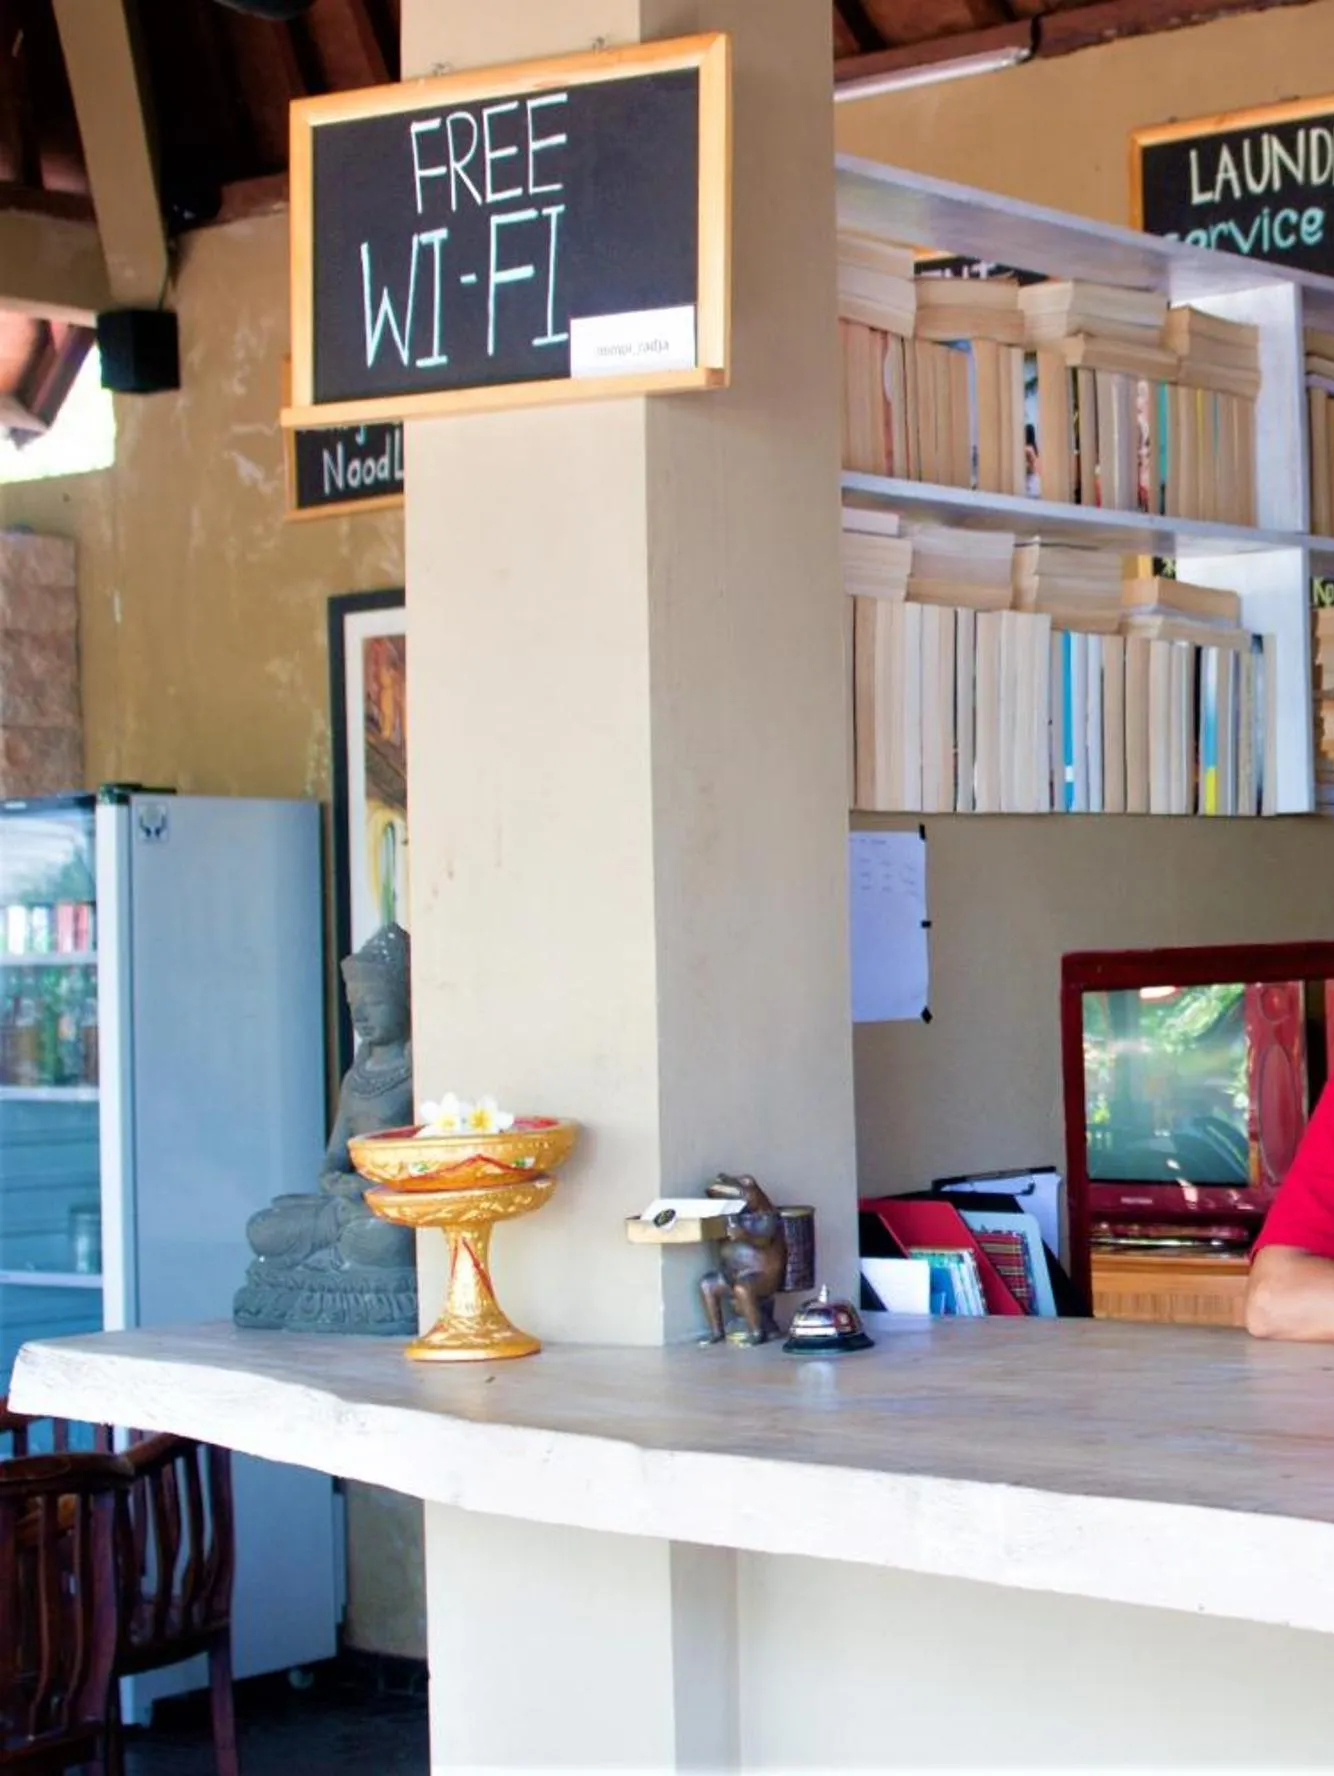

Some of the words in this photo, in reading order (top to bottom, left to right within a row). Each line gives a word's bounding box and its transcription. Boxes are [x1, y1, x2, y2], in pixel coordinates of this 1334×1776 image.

[411, 92, 568, 213] FREE
[360, 204, 570, 367] WI-FI
[1160, 206, 1325, 253] ervice
